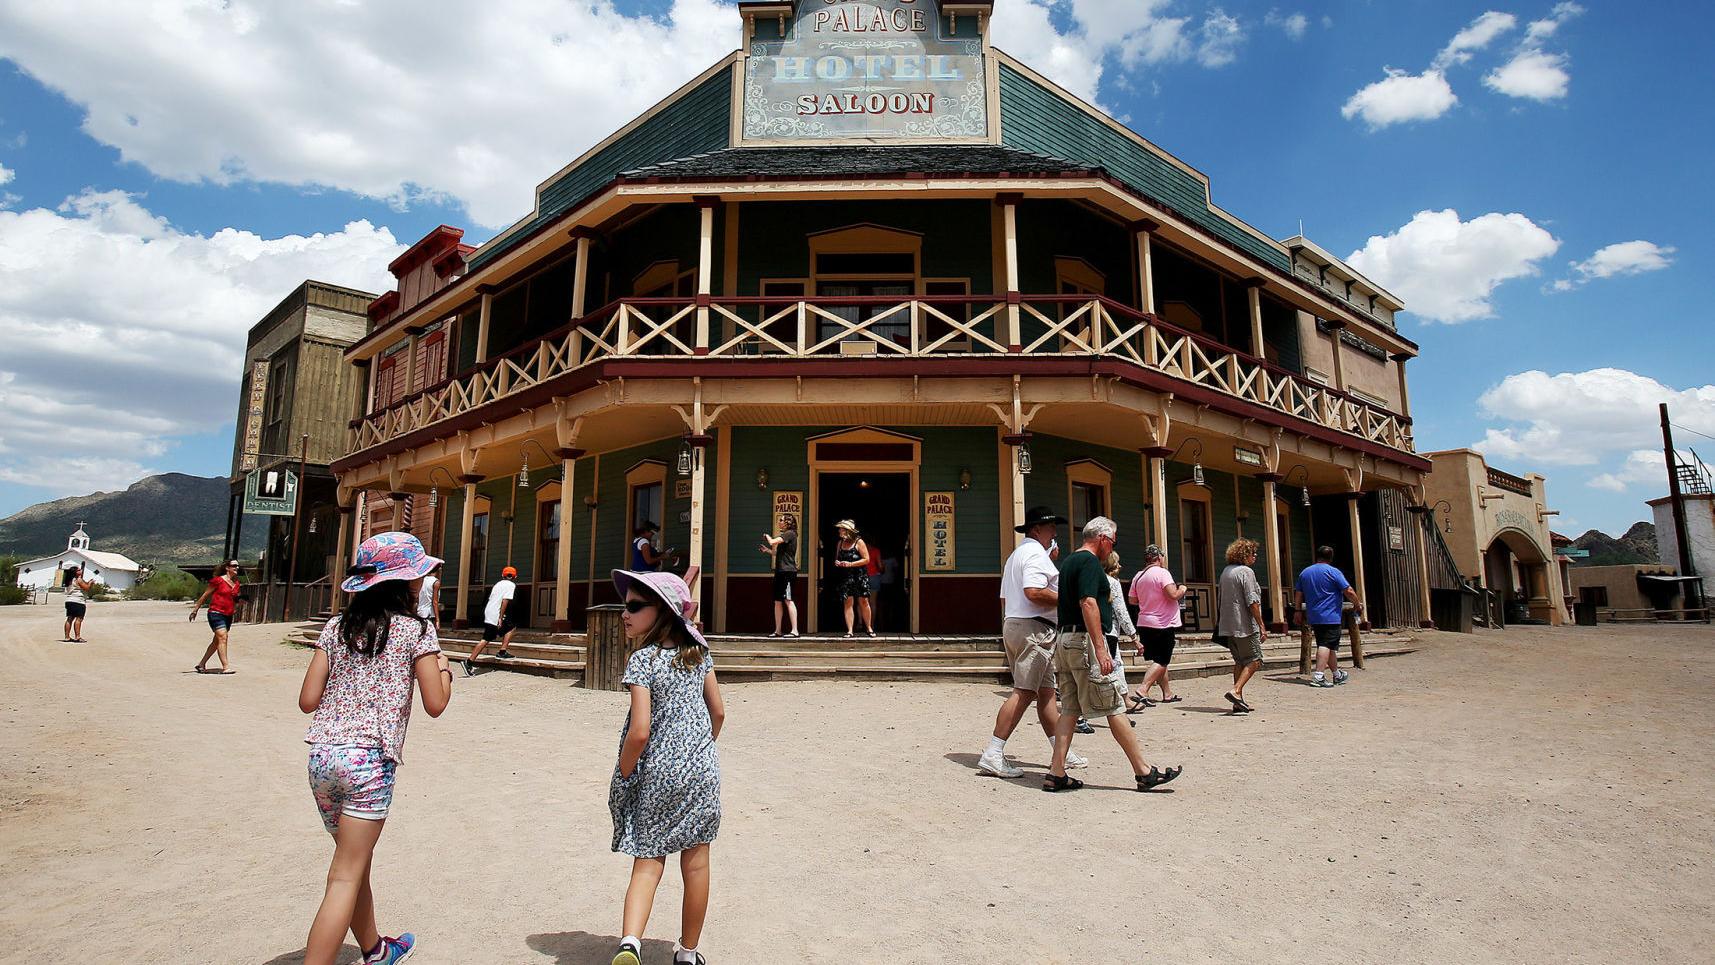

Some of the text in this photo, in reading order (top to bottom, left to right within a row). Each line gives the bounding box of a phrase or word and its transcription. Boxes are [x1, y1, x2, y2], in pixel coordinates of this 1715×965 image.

[813, 5, 927, 32] PALACE
[771, 54, 962, 83] HOTEL
[796, 92, 935, 115] SALOON
[777, 494, 799, 504] GRAND
[928, 494, 950, 505] GRAND
[247, 501, 292, 510] DENTIST
[775, 504, 801, 512] PALACE
[927, 505, 952, 514] PALACE
[933, 521, 947, 566] HOTEL
